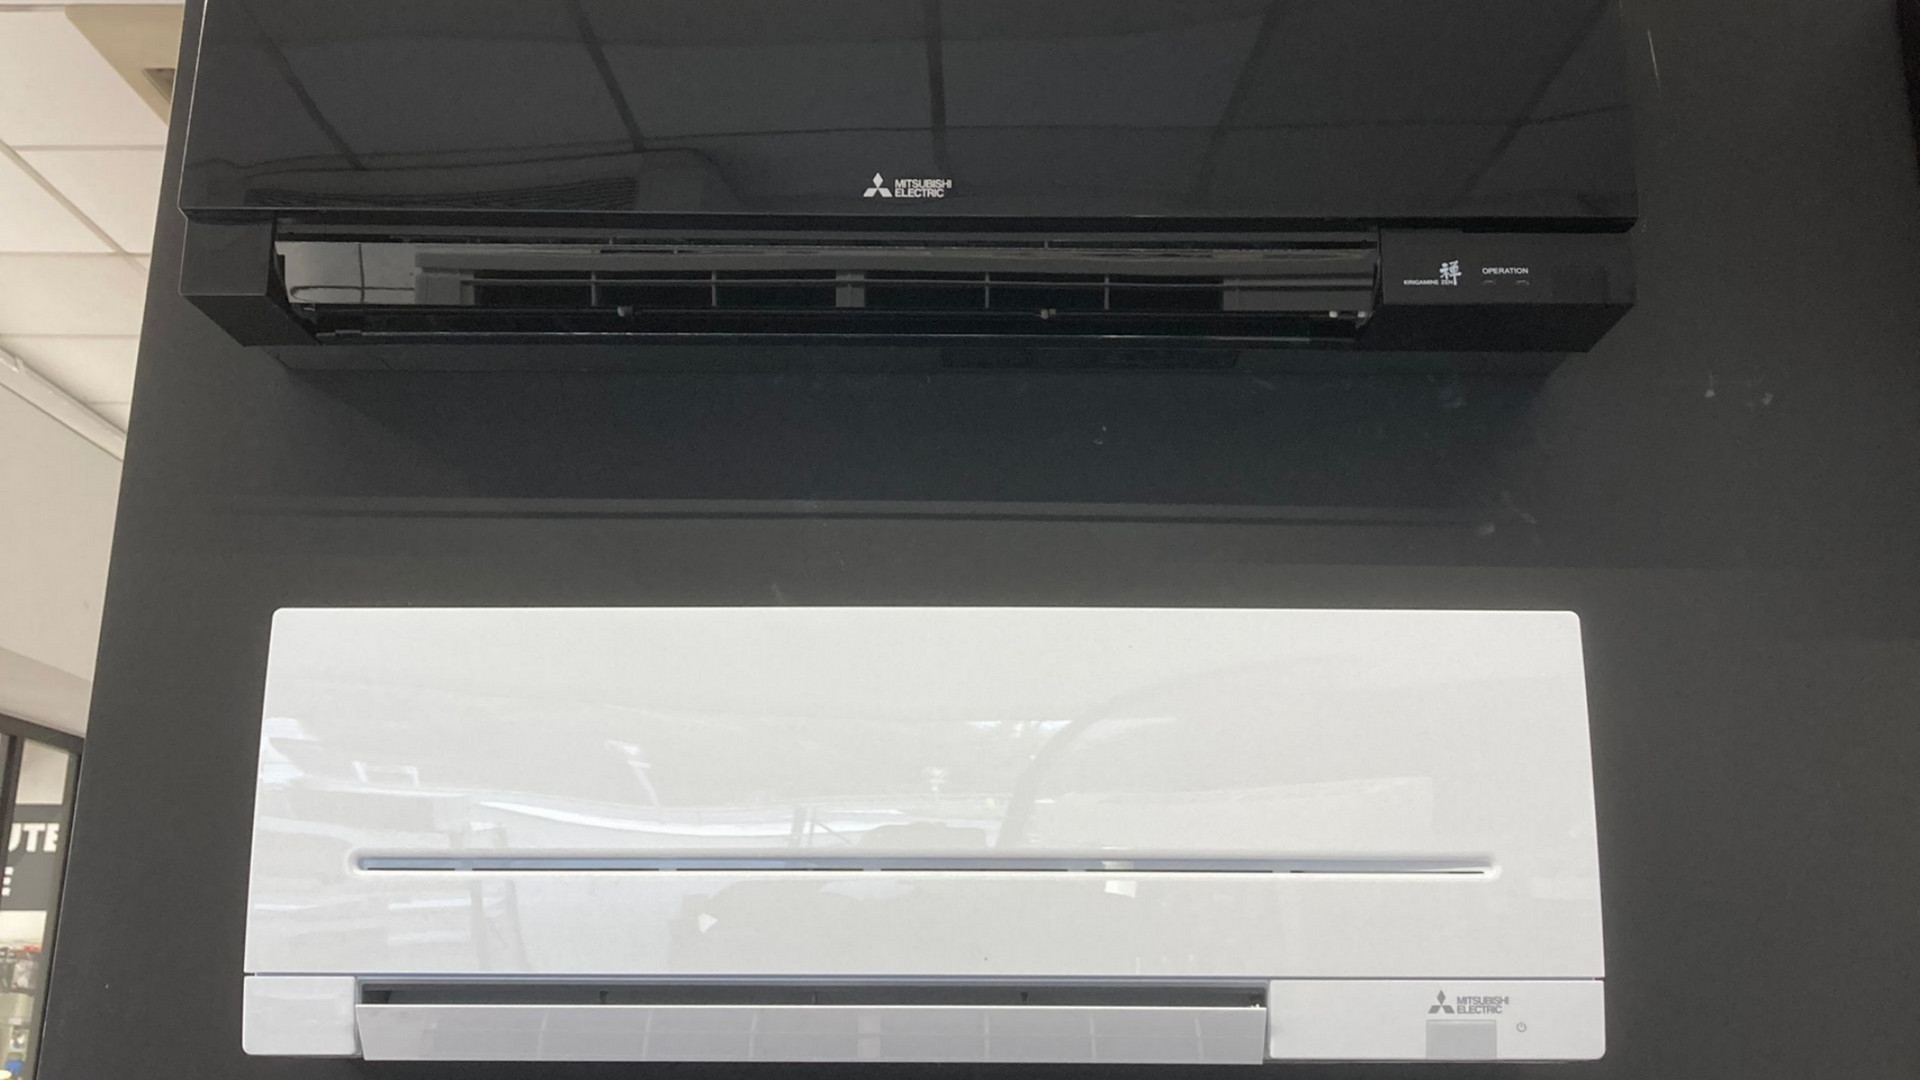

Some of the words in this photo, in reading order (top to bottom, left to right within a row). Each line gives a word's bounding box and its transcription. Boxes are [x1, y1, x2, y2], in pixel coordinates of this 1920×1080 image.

[894, 178, 952, 189] MITSUBISHI
[894, 188, 945, 198] ELECTRIC
[1481, 267, 1529, 275] OPERATION
[1456, 996, 1509, 1005] MITSUBISHI
[1456, 1005, 1503, 1014] ELECTRIC
